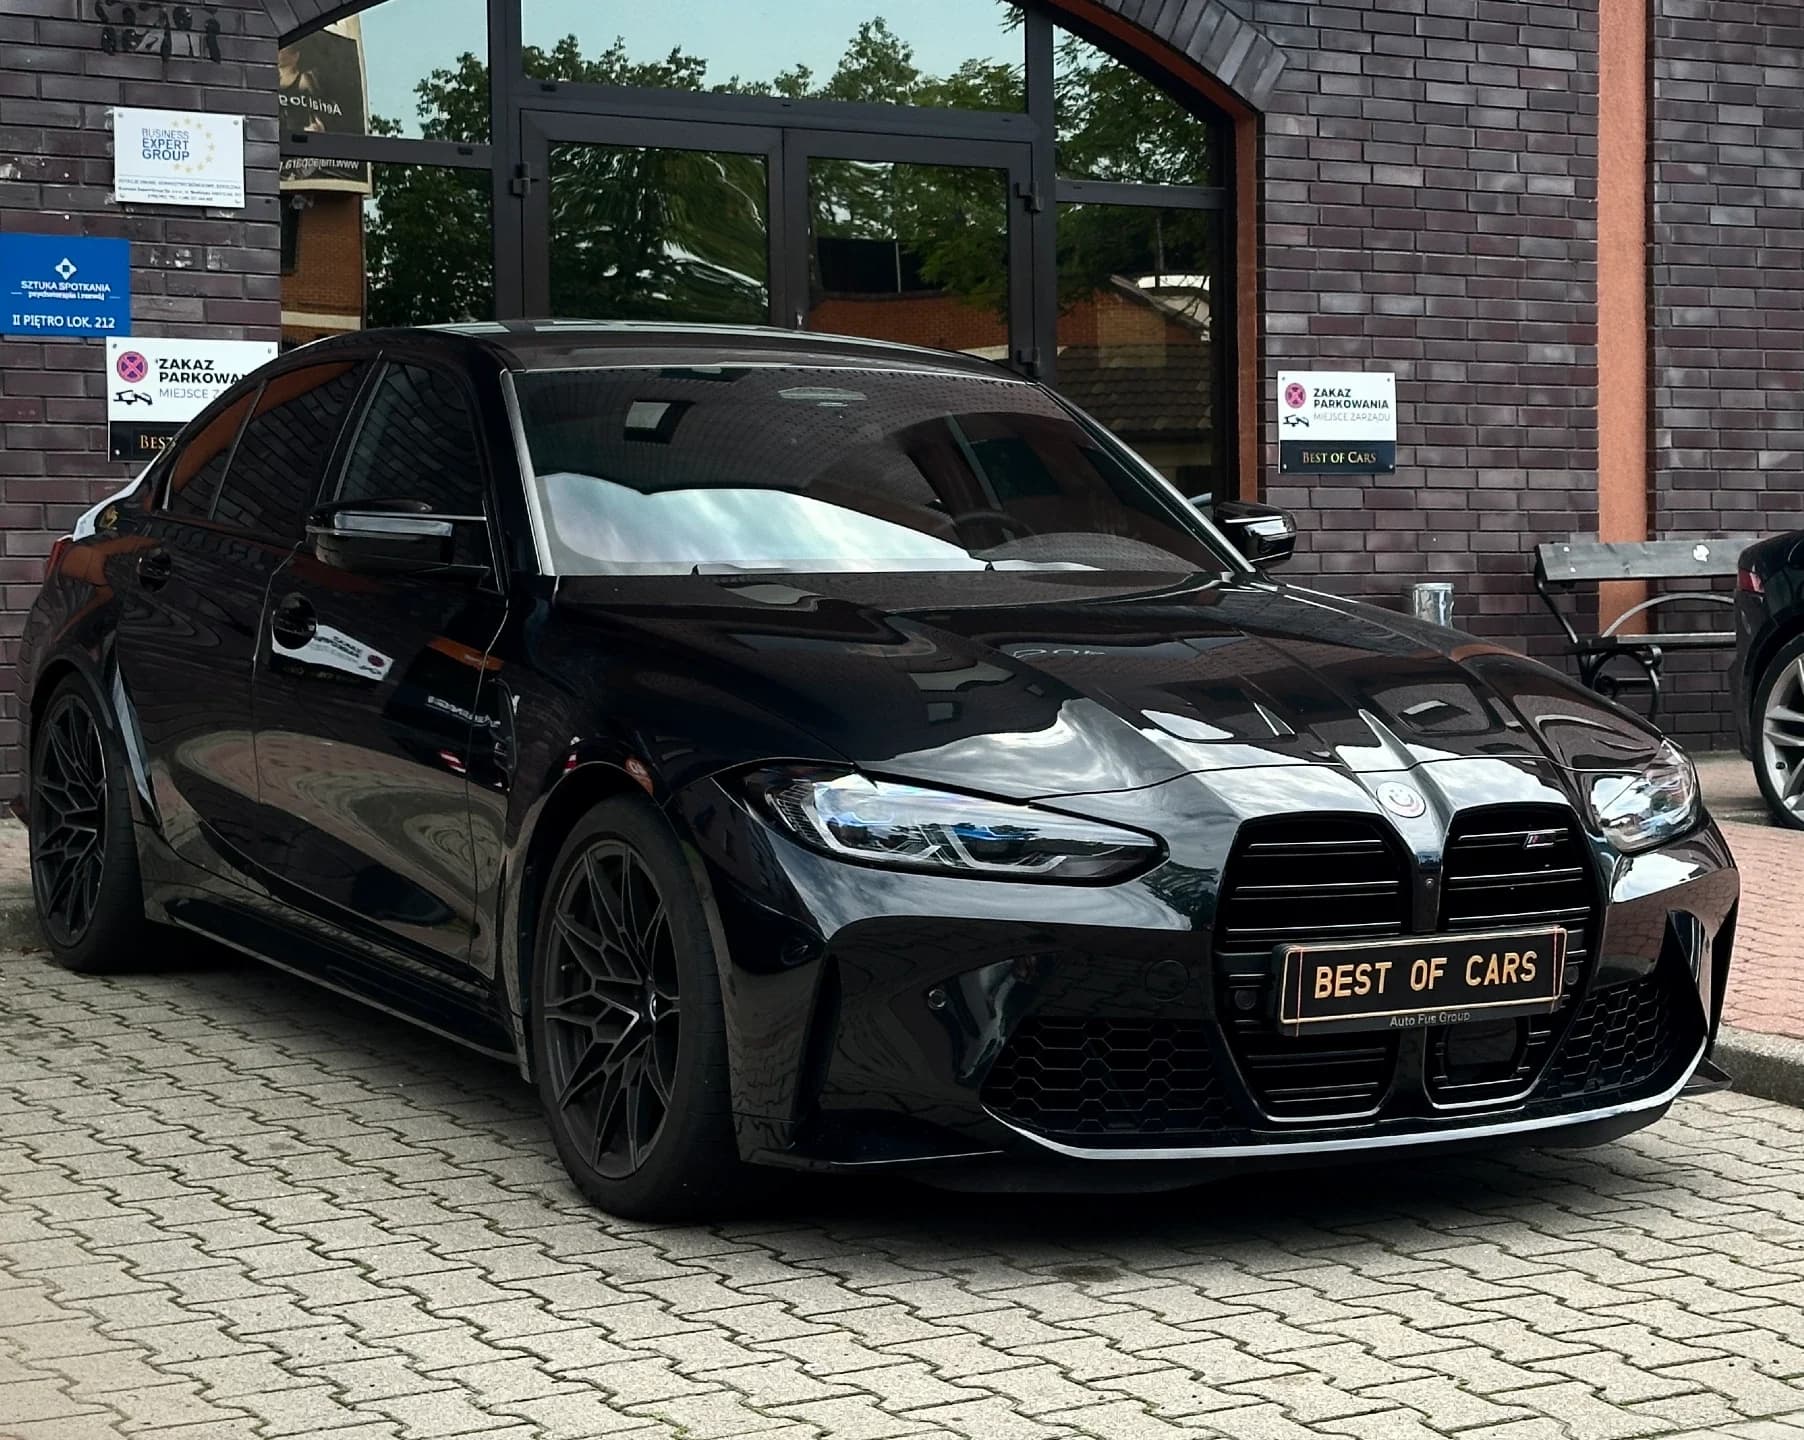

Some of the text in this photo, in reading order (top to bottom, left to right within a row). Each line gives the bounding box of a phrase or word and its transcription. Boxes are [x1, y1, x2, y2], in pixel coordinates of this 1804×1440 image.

[142, 128, 190, 140] BUSINESS
[142, 138, 190, 150] EXPERT
[142, 149, 190, 161] GROUP
[21, 280, 111, 293] SZTUKA SPOTKANIA
[12, 314, 116, 329] II PIĘTRO LOK. 212
[159, 358, 215, 371] ZAKAZ
[159, 388, 209, 399] MIEJSCE
[1313, 388, 1352, 398] ZAKAZ
[1313, 400, 1389, 409] PARKOWANIA
[1313, 412, 1347, 421] MIEJSCE
[1314, 950, 1538, 999] BEST OF CARS
[1389, 1011, 1471, 1028] Auto Fus Group
